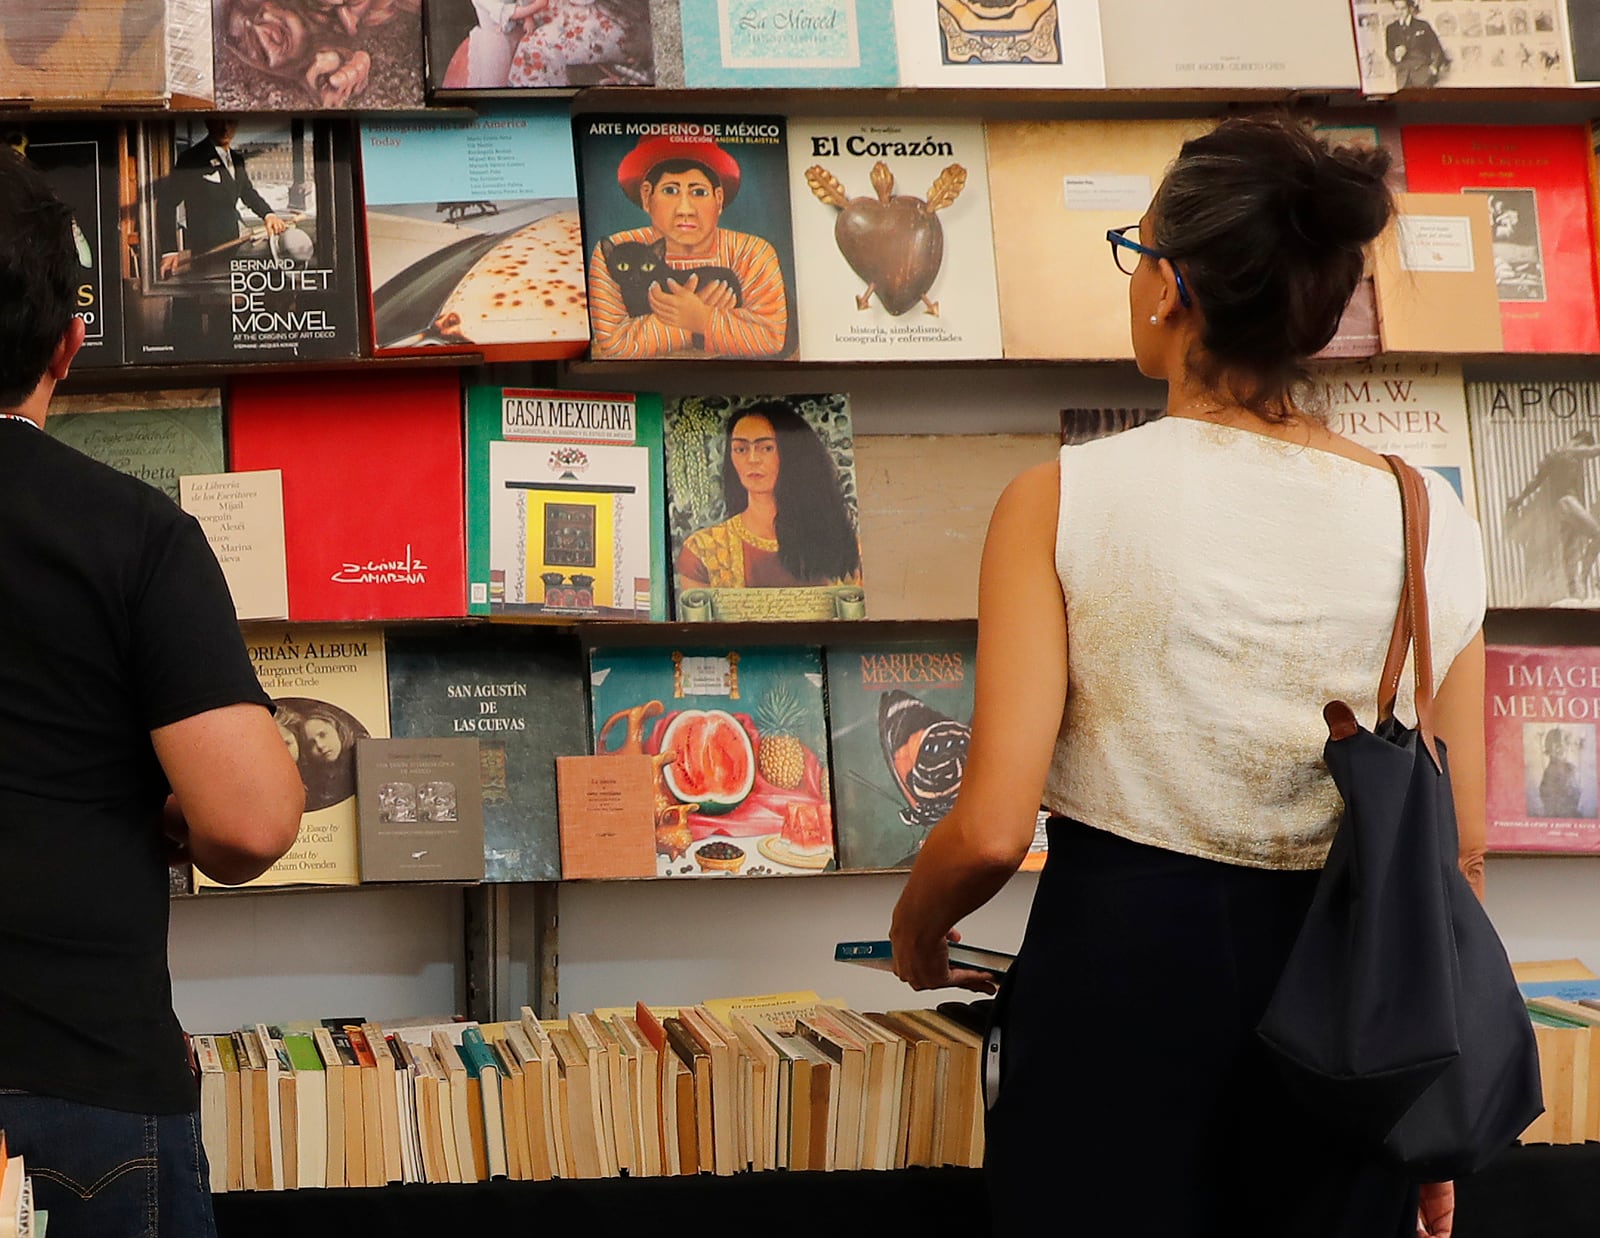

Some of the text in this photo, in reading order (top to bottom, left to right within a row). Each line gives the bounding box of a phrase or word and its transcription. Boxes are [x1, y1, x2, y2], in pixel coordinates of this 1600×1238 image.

[589, 121, 779, 138] ARTE MODERNO DE MÉXICO
[811, 134, 952, 159] El Corazón
[231, 259, 294, 272] BERNARD
[230, 269, 332, 291] BOUTET
[231, 292, 264, 313] DE
[232, 311, 335, 333] MONVEL
[506, 401, 632, 431] CASA MEXICANA
[860, 654, 961, 670] MARIPOSAS
[862, 667, 964, 683] MEXICANAS
[448, 682, 527, 698] SAN AGUSTÍN
[480, 702, 498, 713] DE
[454, 718, 525, 731] LAS CUEVAS
